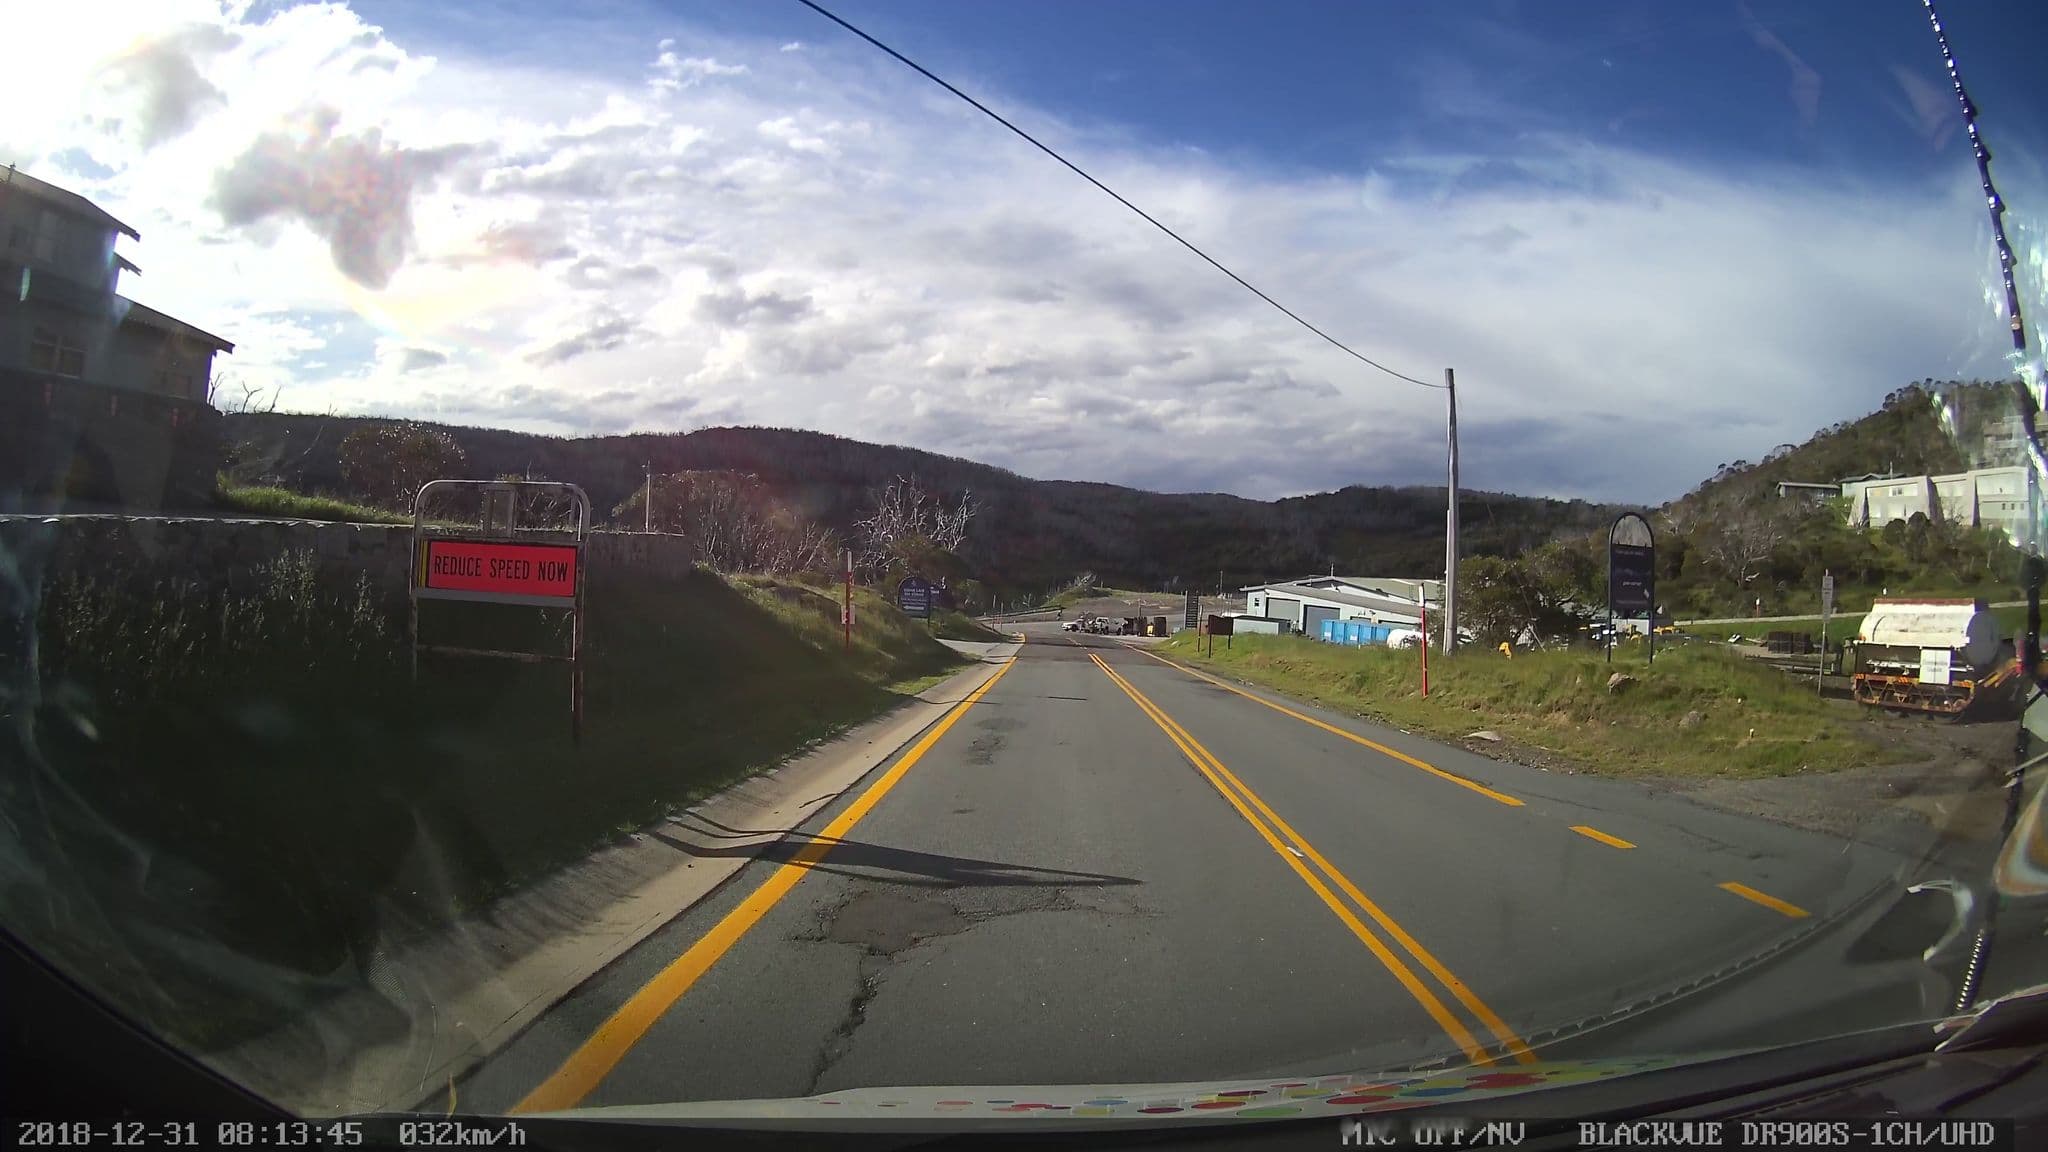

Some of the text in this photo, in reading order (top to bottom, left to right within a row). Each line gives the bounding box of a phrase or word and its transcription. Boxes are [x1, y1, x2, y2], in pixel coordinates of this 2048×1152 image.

[434, 555, 569, 582] REDUCE SPEED NOW
